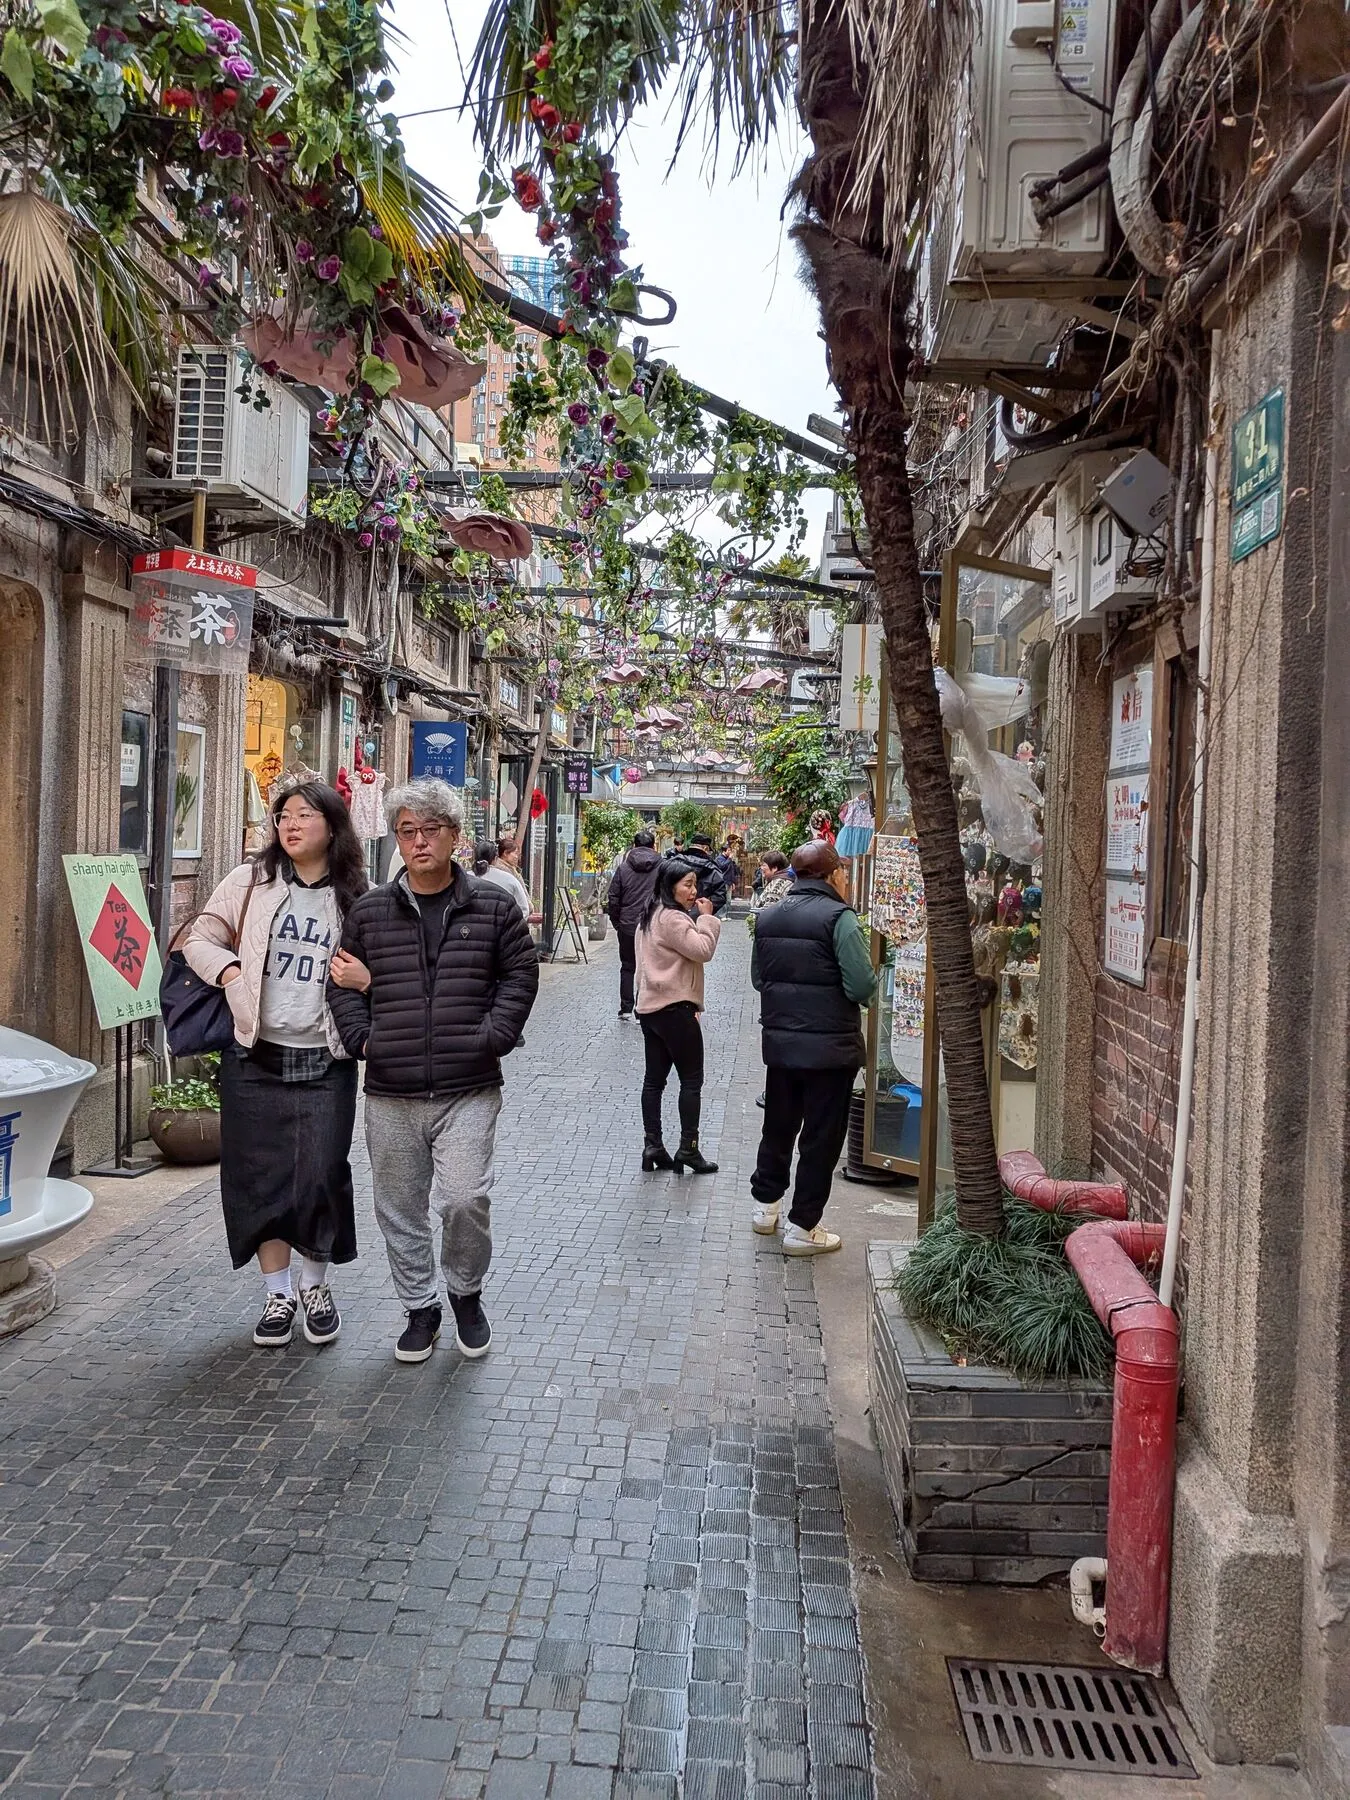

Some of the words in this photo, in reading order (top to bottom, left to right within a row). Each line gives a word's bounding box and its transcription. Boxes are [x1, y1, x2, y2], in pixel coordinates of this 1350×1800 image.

[1244, 407, 1269, 469] 31
[187, 591, 235, 645] 茶
[424, 765, 455, 775] 京扇子
[72, 862, 104, 877] shang
[105, 861, 119, 874] hai
[119, 861, 136, 876] gifts
[106, 901, 128, 914] Tea
[112, 916, 142, 974] 茶
